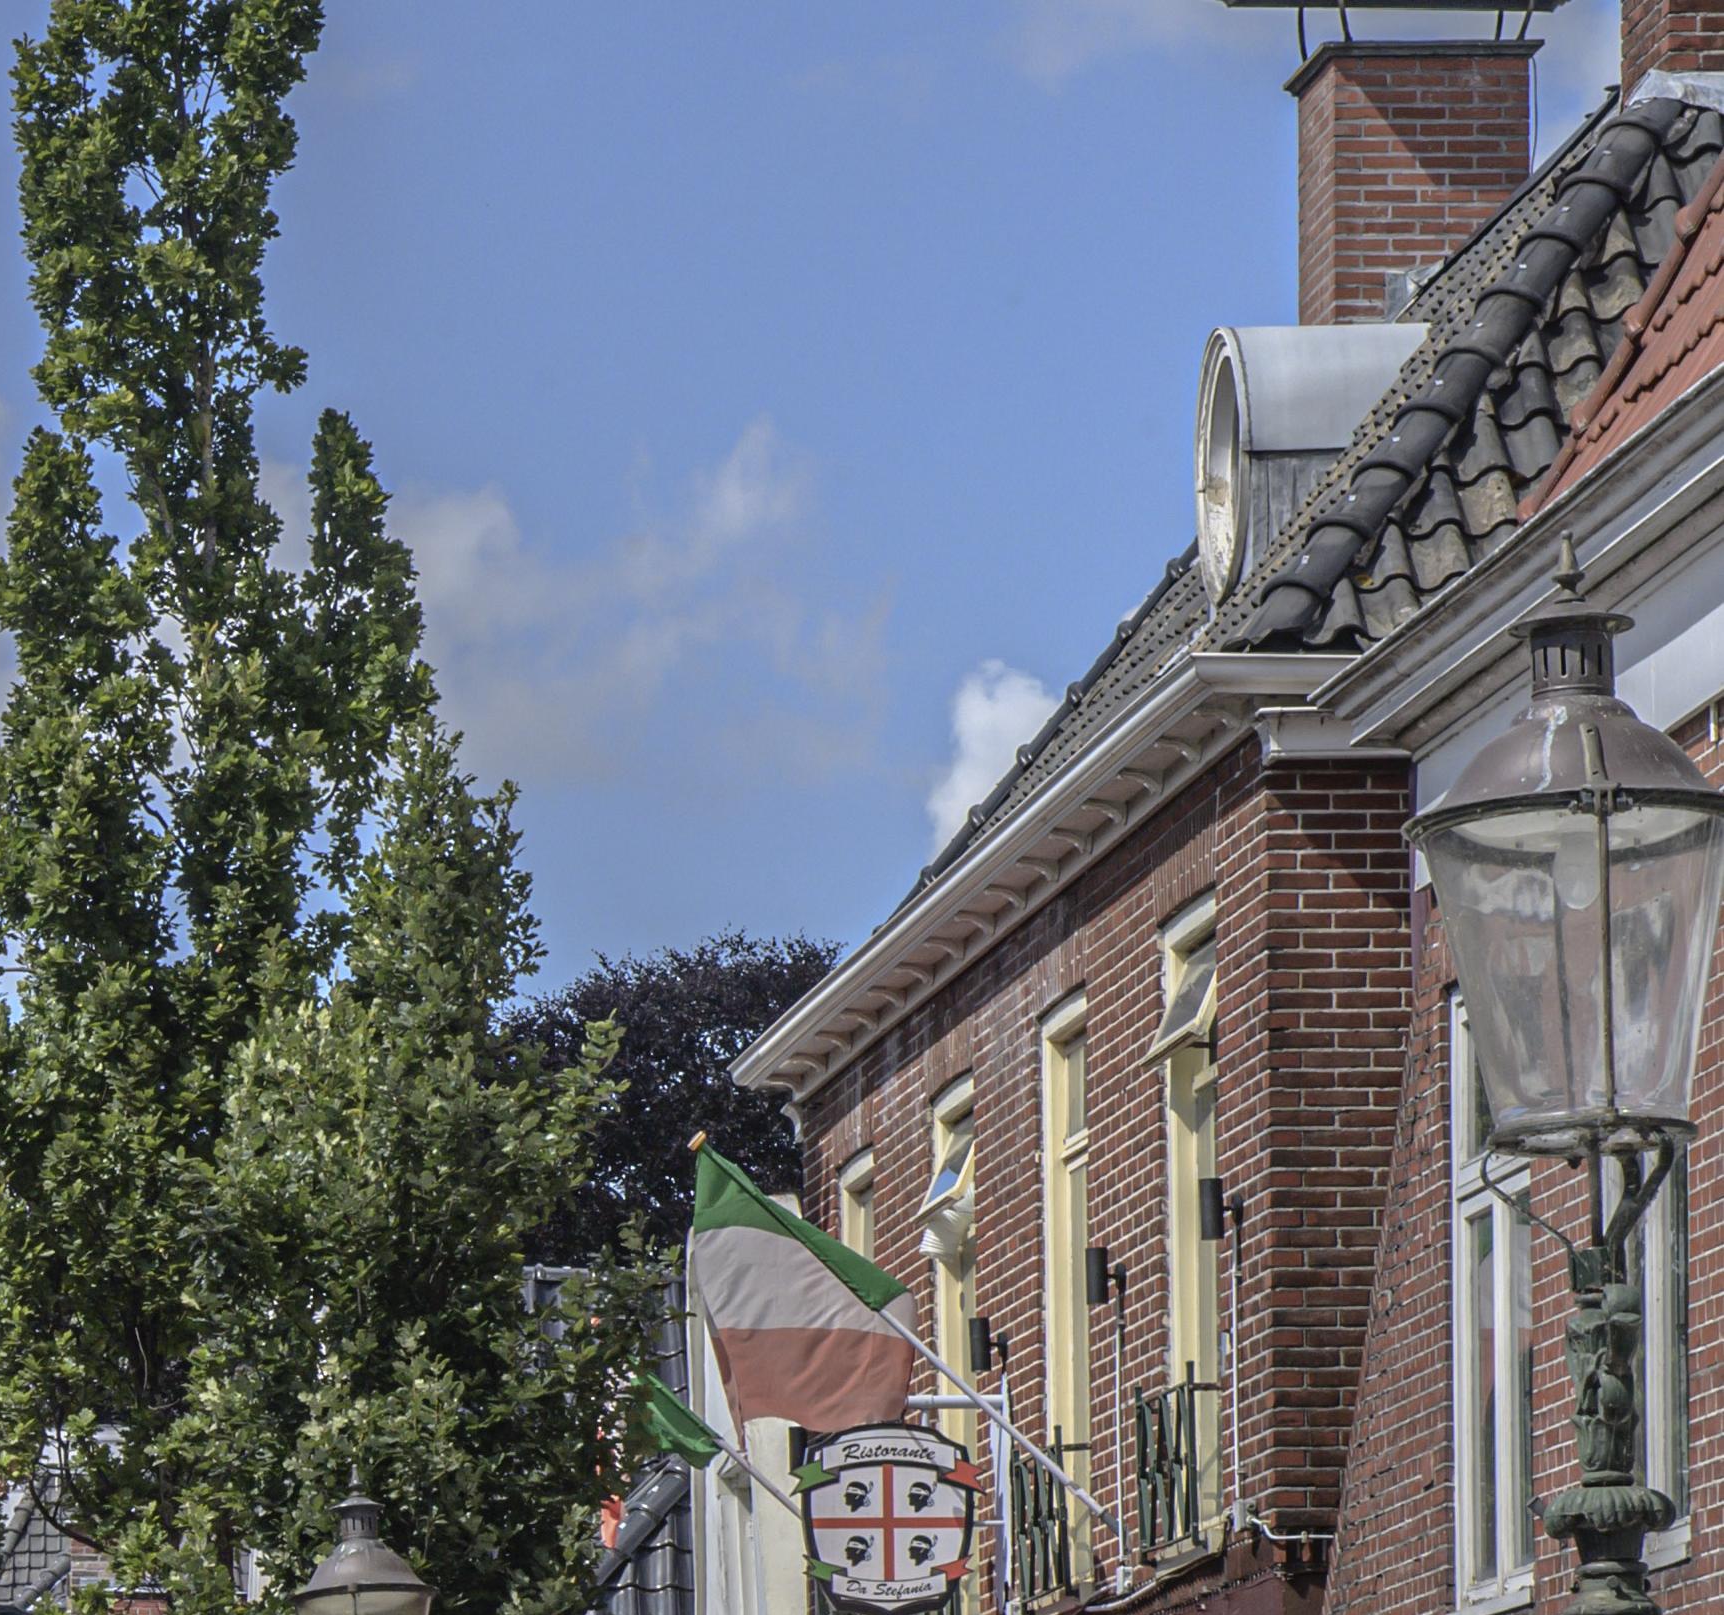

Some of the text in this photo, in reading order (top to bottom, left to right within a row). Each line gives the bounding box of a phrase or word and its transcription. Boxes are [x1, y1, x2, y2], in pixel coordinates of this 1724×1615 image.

[842, 1442, 936, 1461] Ristorante
[846, 1580, 932, 1597] Da Stefania
